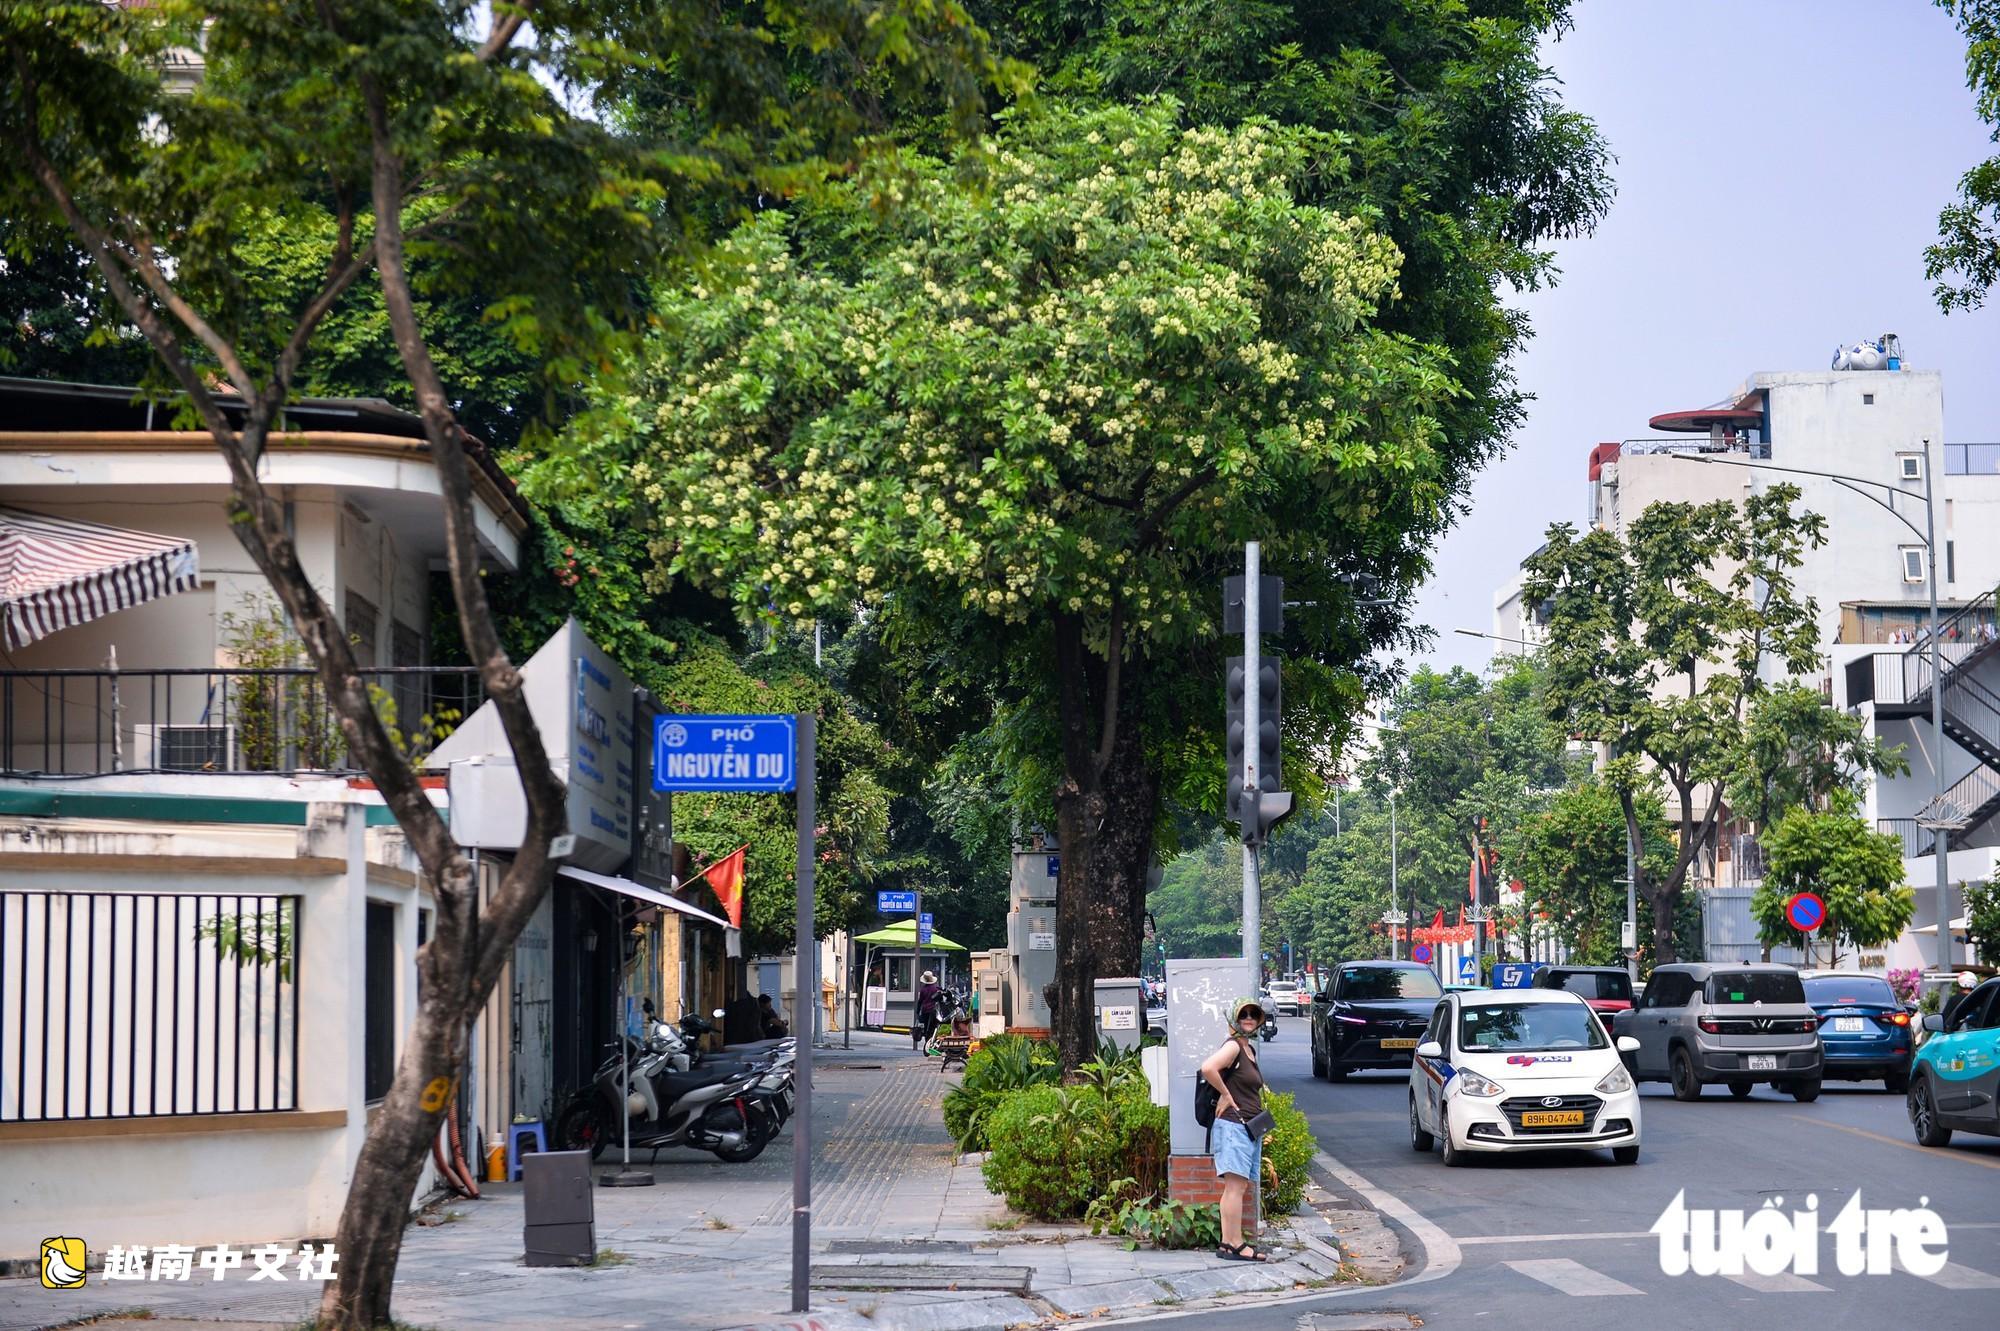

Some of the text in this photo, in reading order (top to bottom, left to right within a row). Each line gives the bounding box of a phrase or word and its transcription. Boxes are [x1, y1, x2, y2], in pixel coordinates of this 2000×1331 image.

[711, 723, 757, 741] PHỐ
[667, 744, 784, 778] NGUYỄN DU
[1503, 966, 1523, 987] G7
